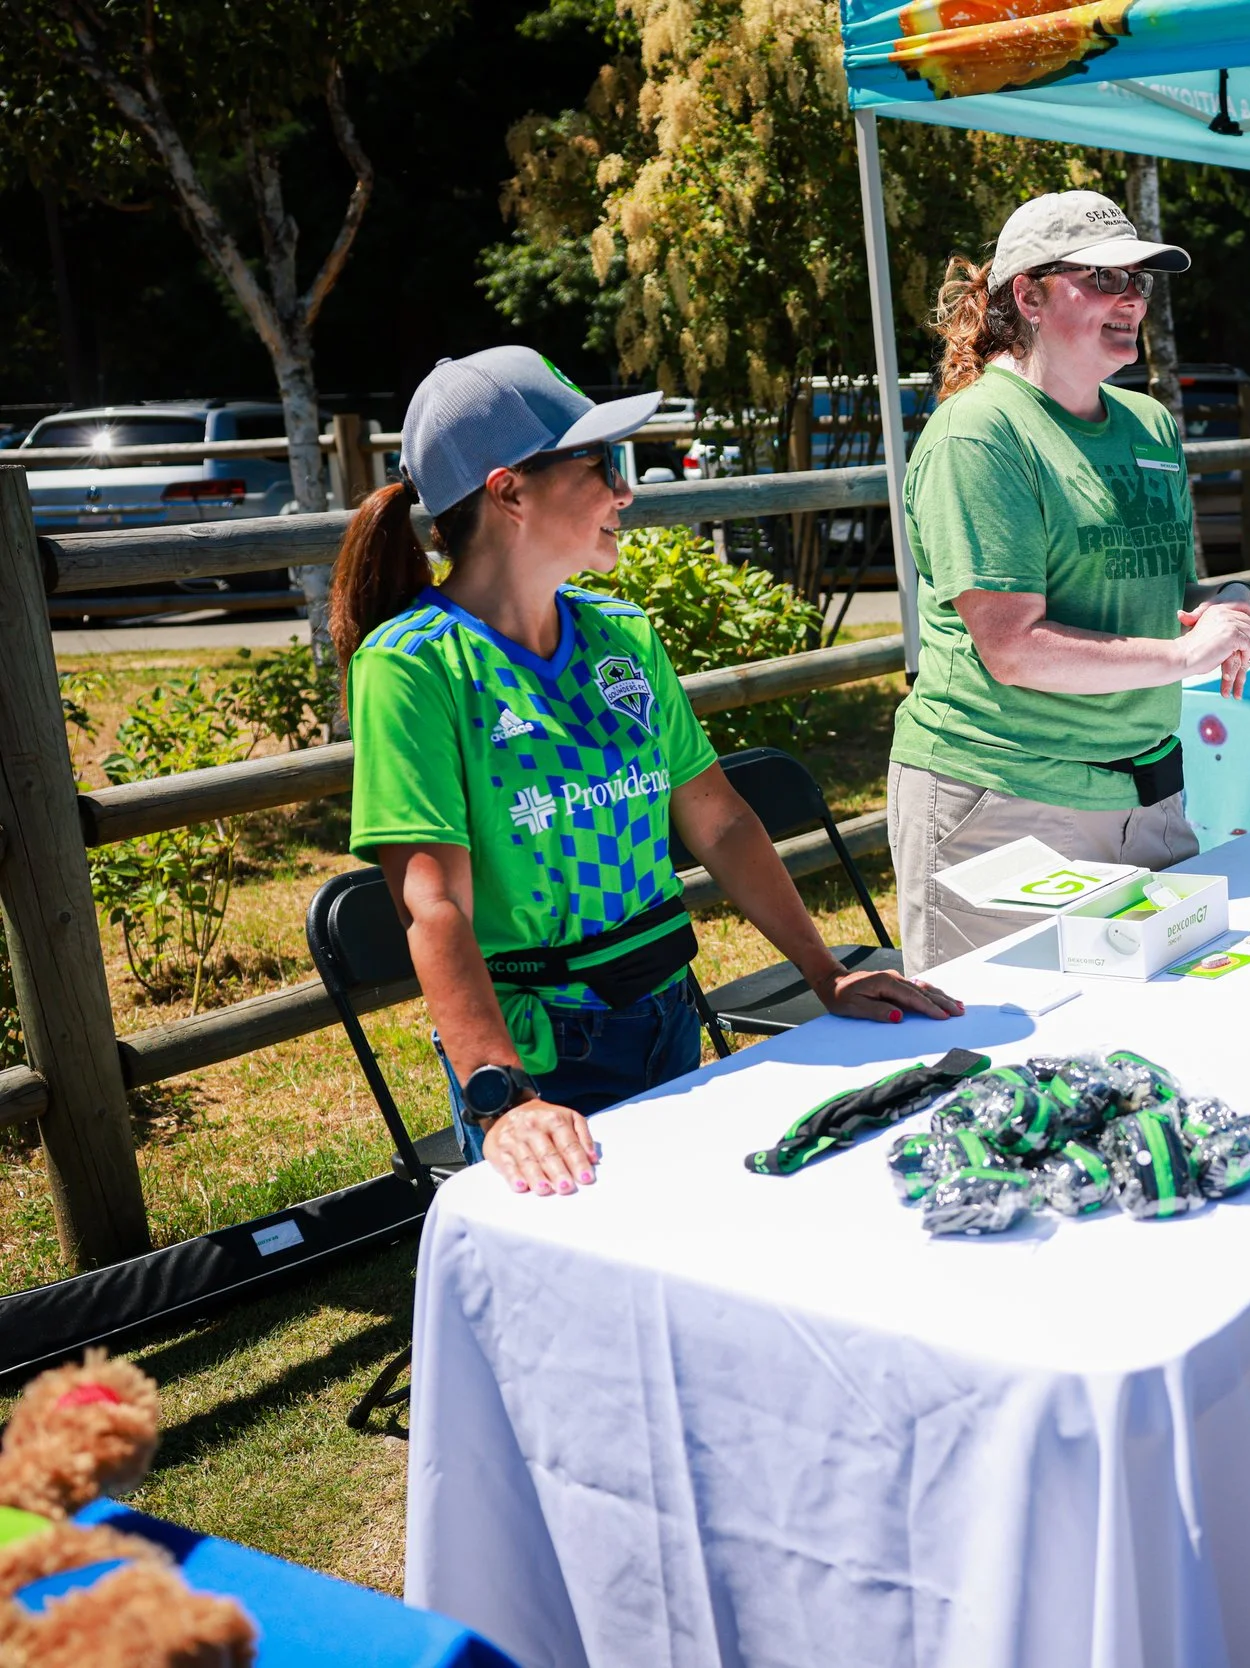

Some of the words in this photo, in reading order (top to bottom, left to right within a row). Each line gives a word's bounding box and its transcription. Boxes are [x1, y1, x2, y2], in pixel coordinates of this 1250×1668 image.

[608, 685, 638, 700] SOUNDERS
[638, 684, 647, 692] FC
[490, 722, 534, 742] adidas
[1020, 870, 1102, 895] G7
